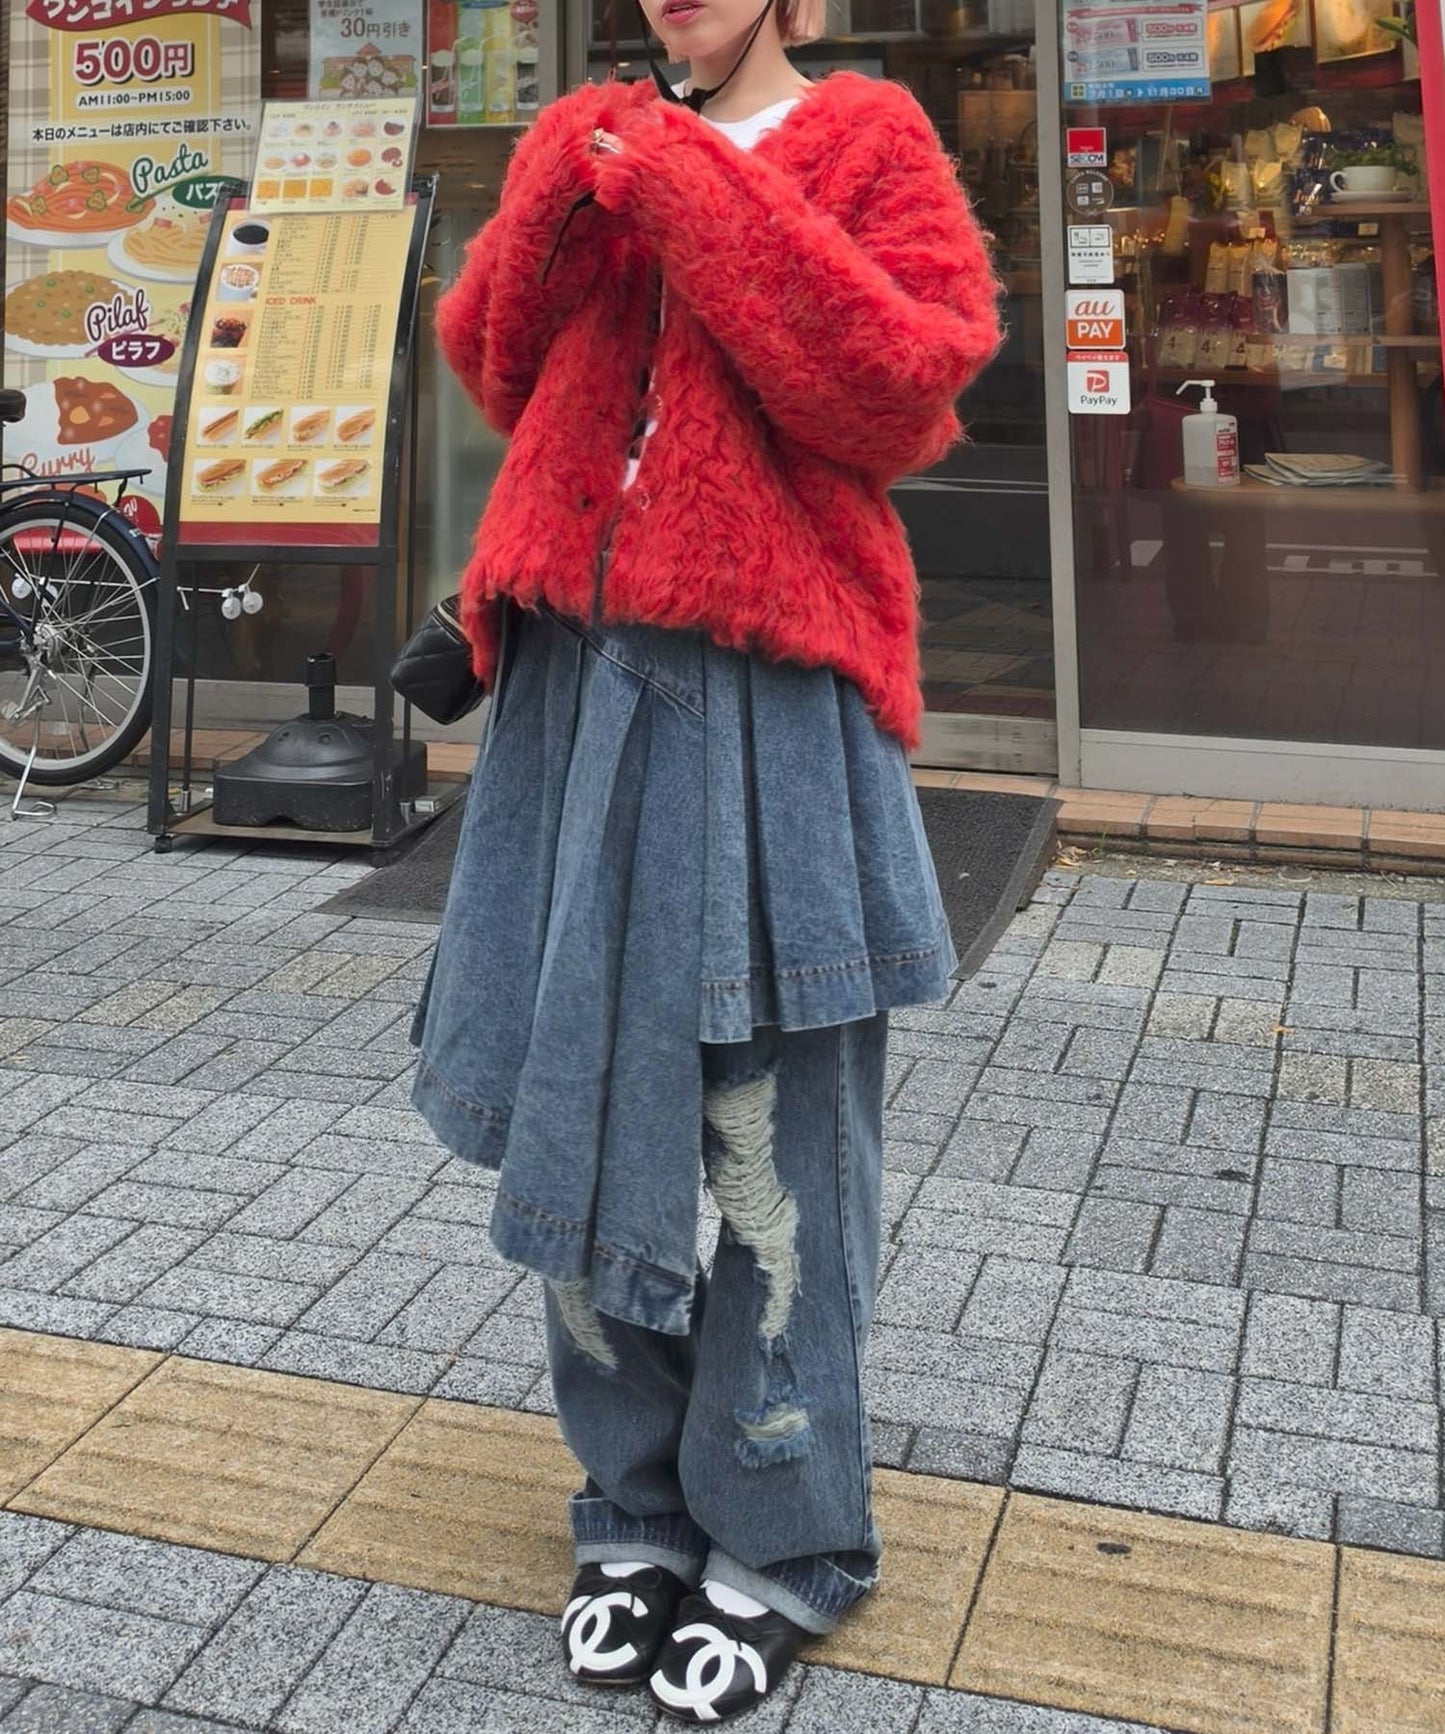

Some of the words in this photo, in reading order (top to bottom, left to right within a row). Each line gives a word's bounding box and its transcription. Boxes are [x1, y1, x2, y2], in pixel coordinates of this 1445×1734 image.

[340, 18, 411, 38] 30円引き
[74, 37, 193, 84] 500円
[32, 119, 251, 142] 本日のメニューは店内にてご確認下さい。
[133, 144, 208, 194] Pasta
[186, 182, 224, 200] パス
[87, 289, 149, 342] Pilaf
[1075, 300, 1115, 317] au
[1077, 321, 1113, 338] PAY
[111, 341, 161, 361] ピラフ
[1080, 395, 1118, 406] PayPay
